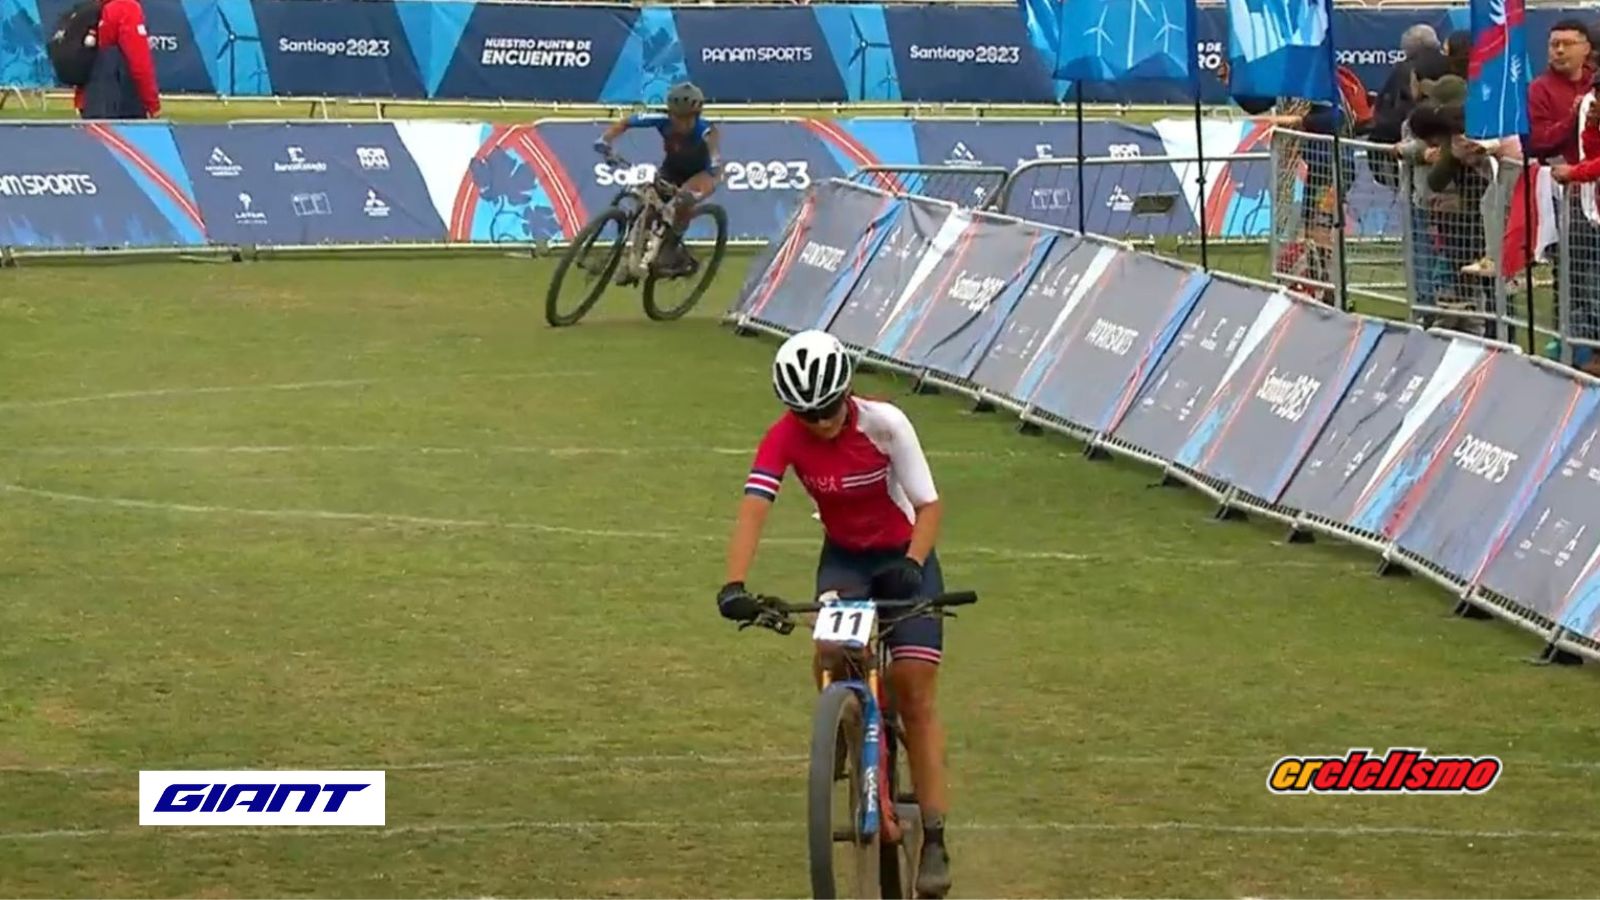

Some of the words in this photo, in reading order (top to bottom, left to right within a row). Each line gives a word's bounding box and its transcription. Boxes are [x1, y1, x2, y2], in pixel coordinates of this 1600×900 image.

[148, 35, 178, 51] RTS
[279, 37, 346, 55] Santiago
[346, 38, 390, 57] 2023
[484, 38, 536, 49] NUESTRO
[537, 40, 575, 50] PUNTO
[576, 41, 593, 51] DE
[481, 49, 591, 67] ENCUENTRO
[910, 44, 975, 63] Santiago
[975, 45, 1020, 63] 2023
[724, 161, 812, 190] 2023
[829, 610, 863, 636] 11
